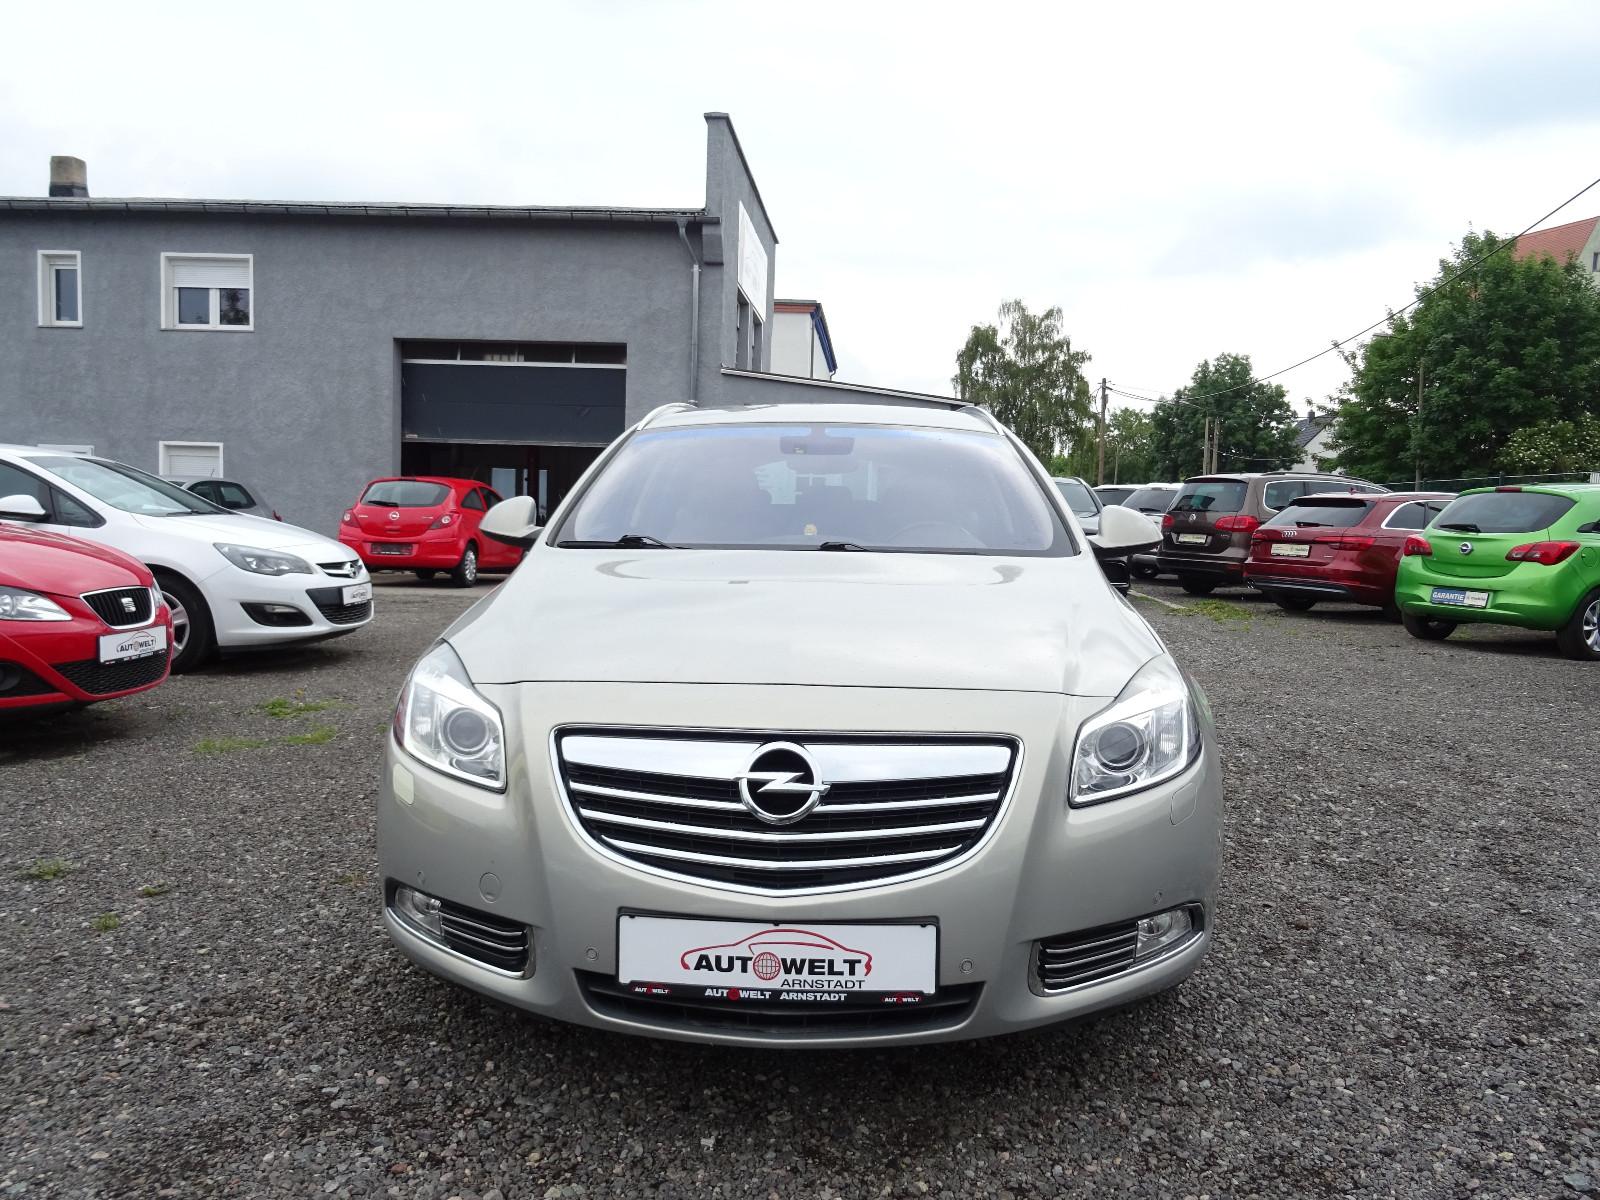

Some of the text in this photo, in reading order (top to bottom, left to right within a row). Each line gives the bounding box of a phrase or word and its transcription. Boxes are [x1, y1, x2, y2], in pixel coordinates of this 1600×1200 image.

[1432, 592, 1465, 601] GARANTIE
[780, 978, 866, 989] ARNSTADT
[780, 991, 848, 1001] ARNSTADT
